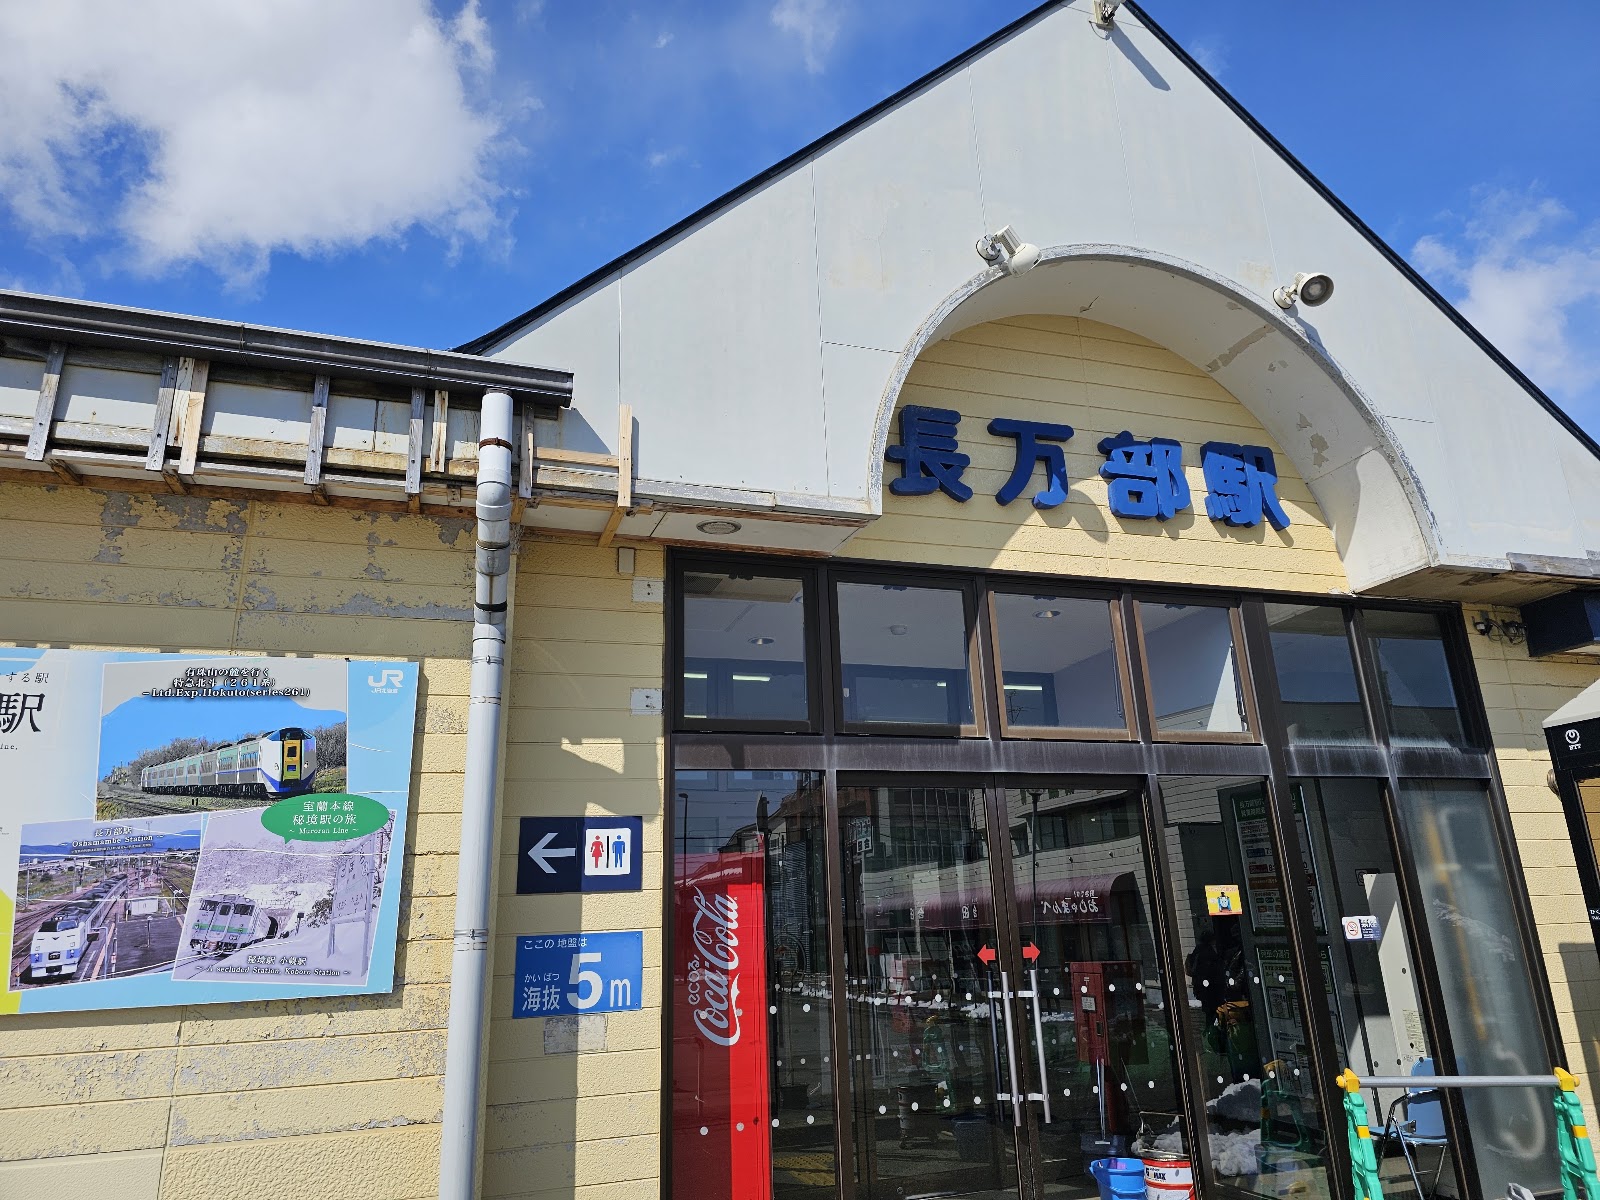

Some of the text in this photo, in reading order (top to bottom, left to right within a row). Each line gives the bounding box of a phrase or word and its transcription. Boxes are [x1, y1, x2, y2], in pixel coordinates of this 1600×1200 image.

[886, 405, 1290, 531] 長万部駅
[368, 670, 403, 687] JR
[303, 800, 354, 812] 室蘭本線
[293, 814, 357, 826] 秘境駅の旅
[95, 826, 133, 837] 長万部駅
[72, 835, 153, 847] Oshamambe Station
[524, 937, 588, 949] ここの 地盤は
[247, 956, 275, 965] 秘境駅
[693, 886, 741, 1046] Coca-Cola
[522, 952, 631, 1012] 海抜 5 m
[524, 973, 560, 983] かい ばつ
